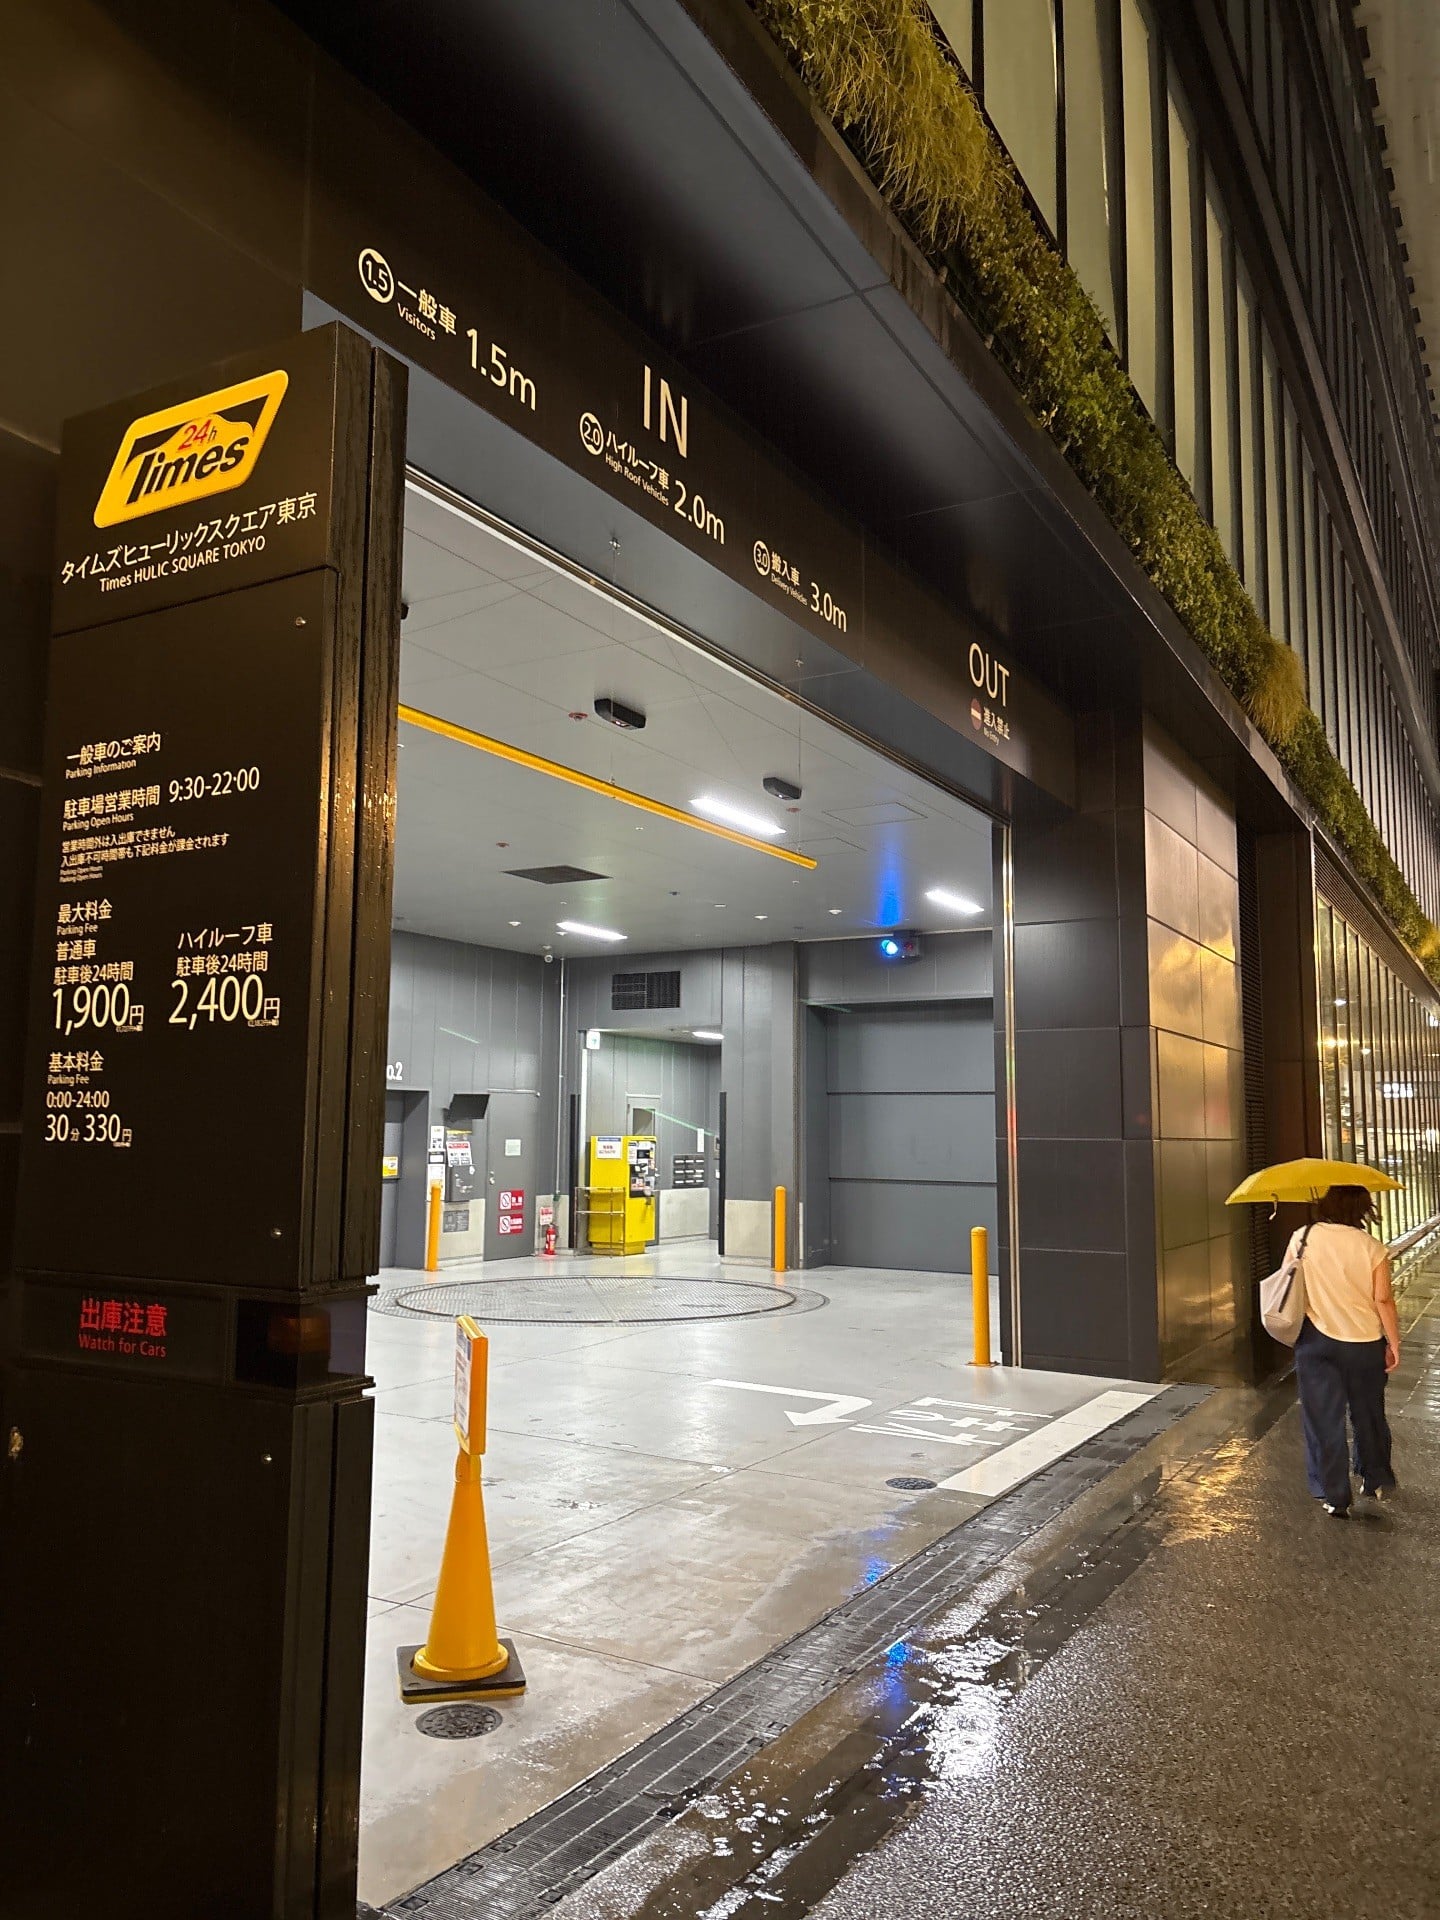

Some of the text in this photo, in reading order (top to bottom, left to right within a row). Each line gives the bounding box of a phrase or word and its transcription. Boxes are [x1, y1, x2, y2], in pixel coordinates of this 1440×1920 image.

[366, 260, 536, 411] 1.5 一般車 1.5m
[397, 302, 436, 341] Visitors
[643, 364, 688, 459] IN
[176, 418, 218, 454] 24h
[126, 435, 251, 505] Times
[583, 420, 725, 545] 2.0 ハイルーフ車 2.0m
[605, 452, 670, 506] High Roof Vehicles
[61, 491, 318, 584] タイムズヒューリックスクエア東京
[99, 535, 266, 592] Times HULIC SQUARE TOKYO
[810, 582, 847, 633] 3.0m
[969, 642, 1010, 707] OUT
[66, 731, 161, 766] 一般車のご案内
[65, 758, 137, 780] Parking Information
[63, 766, 260, 820] 駐車場営業時間 9:30-22:00
[62, 812, 134, 832] Parking Open Hours
[56, 922, 98, 936] Parking Fee
[57, 898, 113, 924] 最大料金
[56, 938, 97, 962] 普通車
[177, 921, 273, 950] ハイルーフ車
[53, 961, 134, 986] 駐車後24時間
[175, 950, 268, 977] 駐車後24時間
[52, 982, 144, 1036] 1,900円
[168, 973, 281, 1031] 2,400円
[48, 1050, 104, 1073] 基本料金
[47, 1074, 90, 1087] Parking Fee
[46, 1090, 110, 1109] 0:00-24:00
[79, 1297, 168, 1338] 出庫注意
[78, 1333, 167, 1358] Watch for Cars
